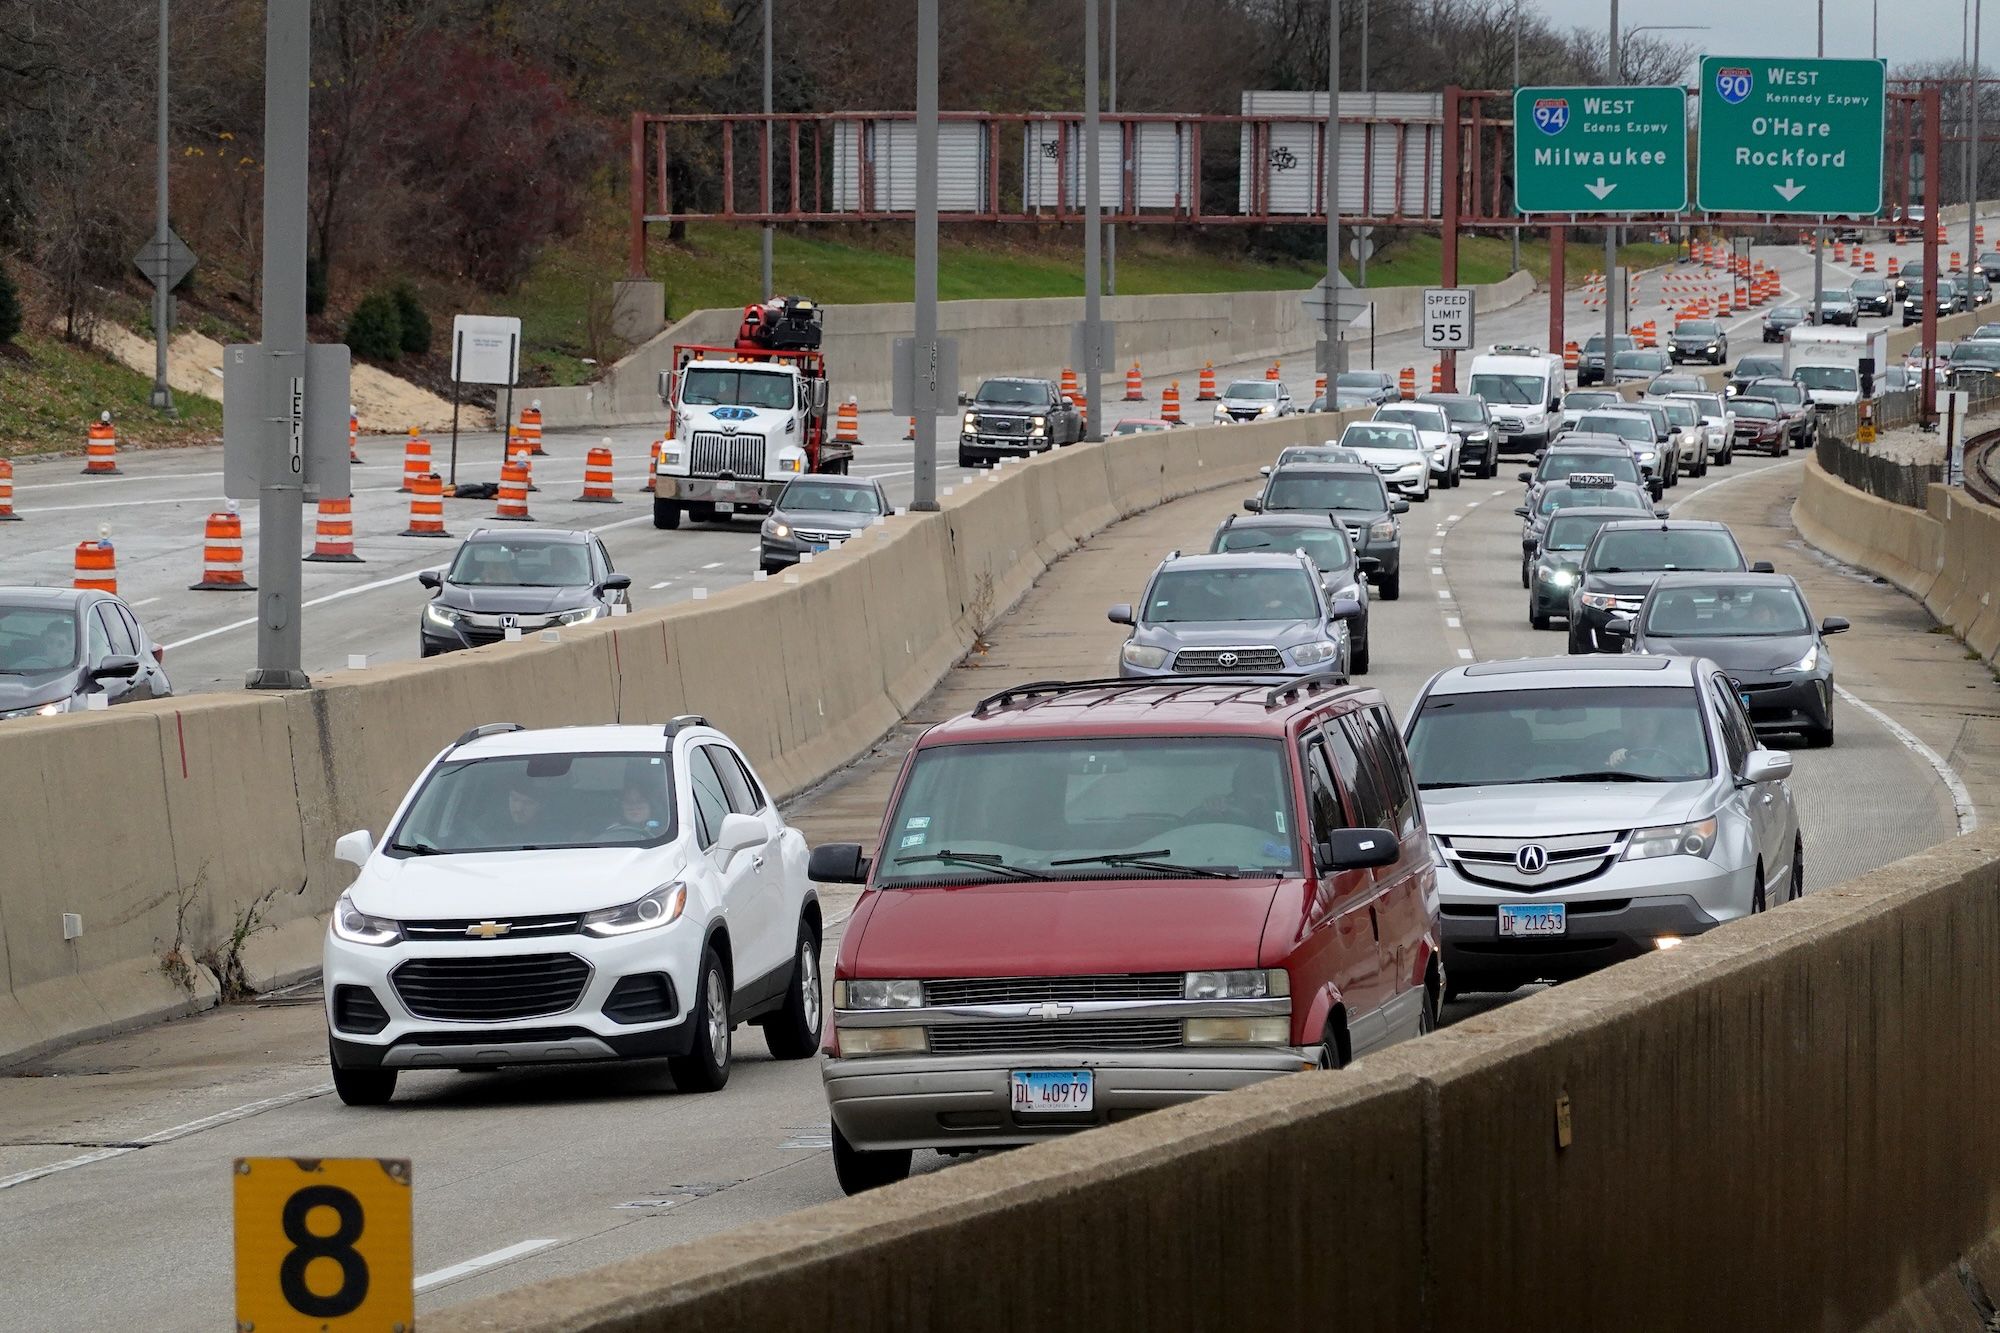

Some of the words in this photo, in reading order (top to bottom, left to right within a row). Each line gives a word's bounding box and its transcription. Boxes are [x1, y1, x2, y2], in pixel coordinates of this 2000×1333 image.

[1767, 67, 1819, 86] WEST
[1720, 77, 1749, 97] 90
[1583, 97, 1634, 115] WEST
[1766, 92, 1821, 106] Kennedy
[1827, 94, 1869, 106] Expwy
[1536, 108, 1565, 128] 94
[1752, 117, 1831, 137] O'Hare
[1583, 122, 1621, 133] Edens
[1626, 122, 1668, 134] Expwy
[1534, 147, 1667, 166] Milwaukee
[1735, 147, 1846, 168] Rockford
[1428, 295, 1467, 305] SPEED
[1431, 309, 1462, 319] LIMIT
[1432, 324, 1462, 341] 55
[1503, 915, 1517, 931] DF
[1525, 914, 1562, 930] 21253
[1016, 1083, 1034, 1103] DL
[1042, 1082, 1088, 1103] 40979
[280, 1184, 370, 1318] 8
